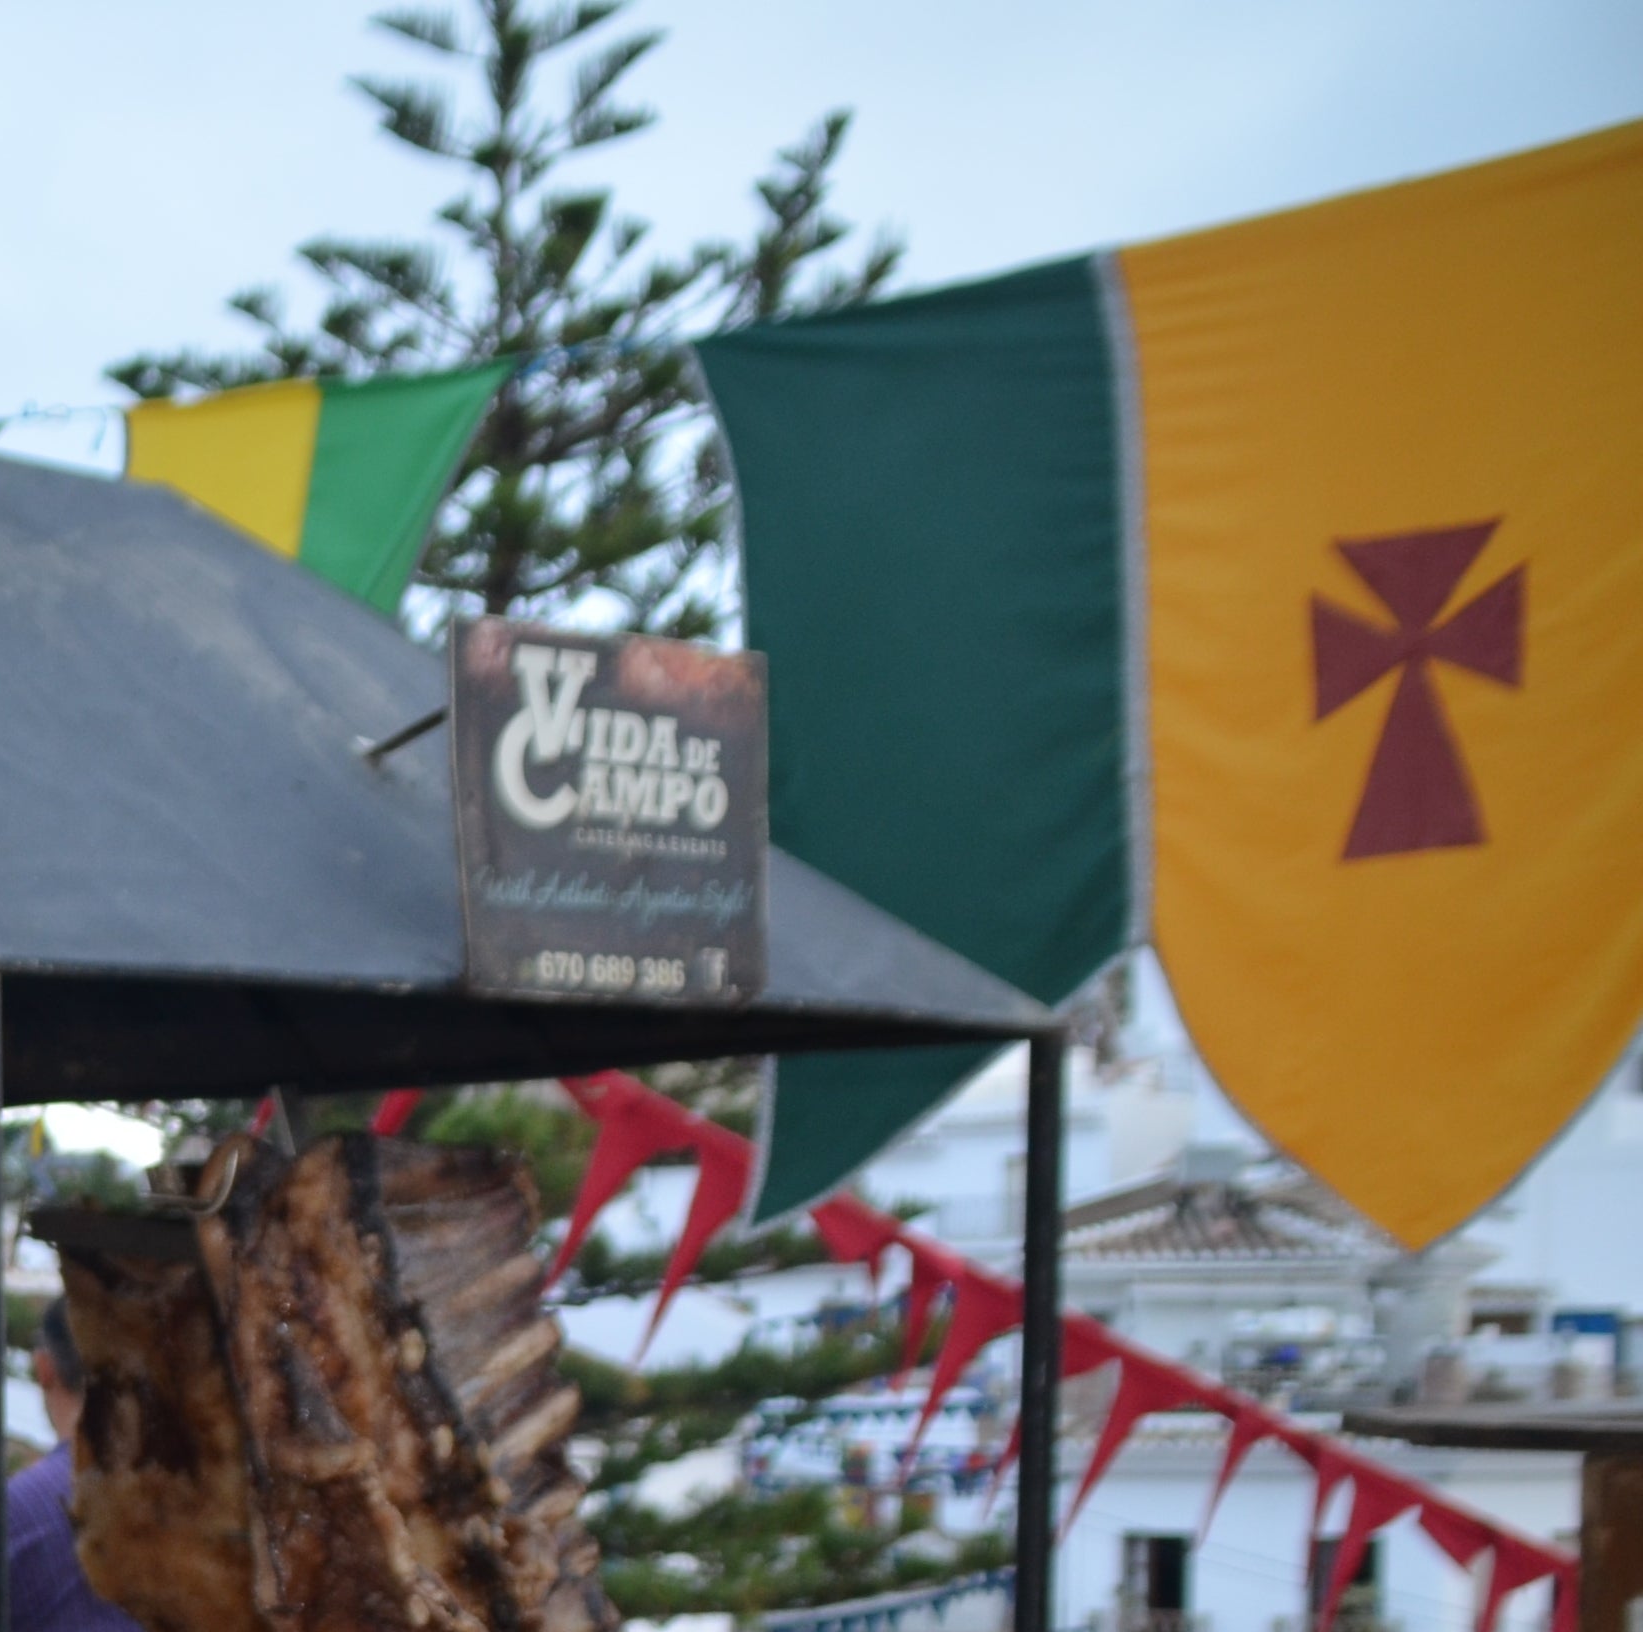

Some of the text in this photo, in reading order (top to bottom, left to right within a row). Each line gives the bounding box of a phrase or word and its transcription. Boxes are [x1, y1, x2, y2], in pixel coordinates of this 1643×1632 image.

[513, 643, 721, 773] VIDA DE
[495, 704, 729, 831] CAMPO
[575, 826, 653, 850] CATERING
[669, 835, 728, 857] EVENTS
[537, 950, 585, 985] 670
[590, 954, 636, 989] 689
[639, 957, 686, 993] 386
